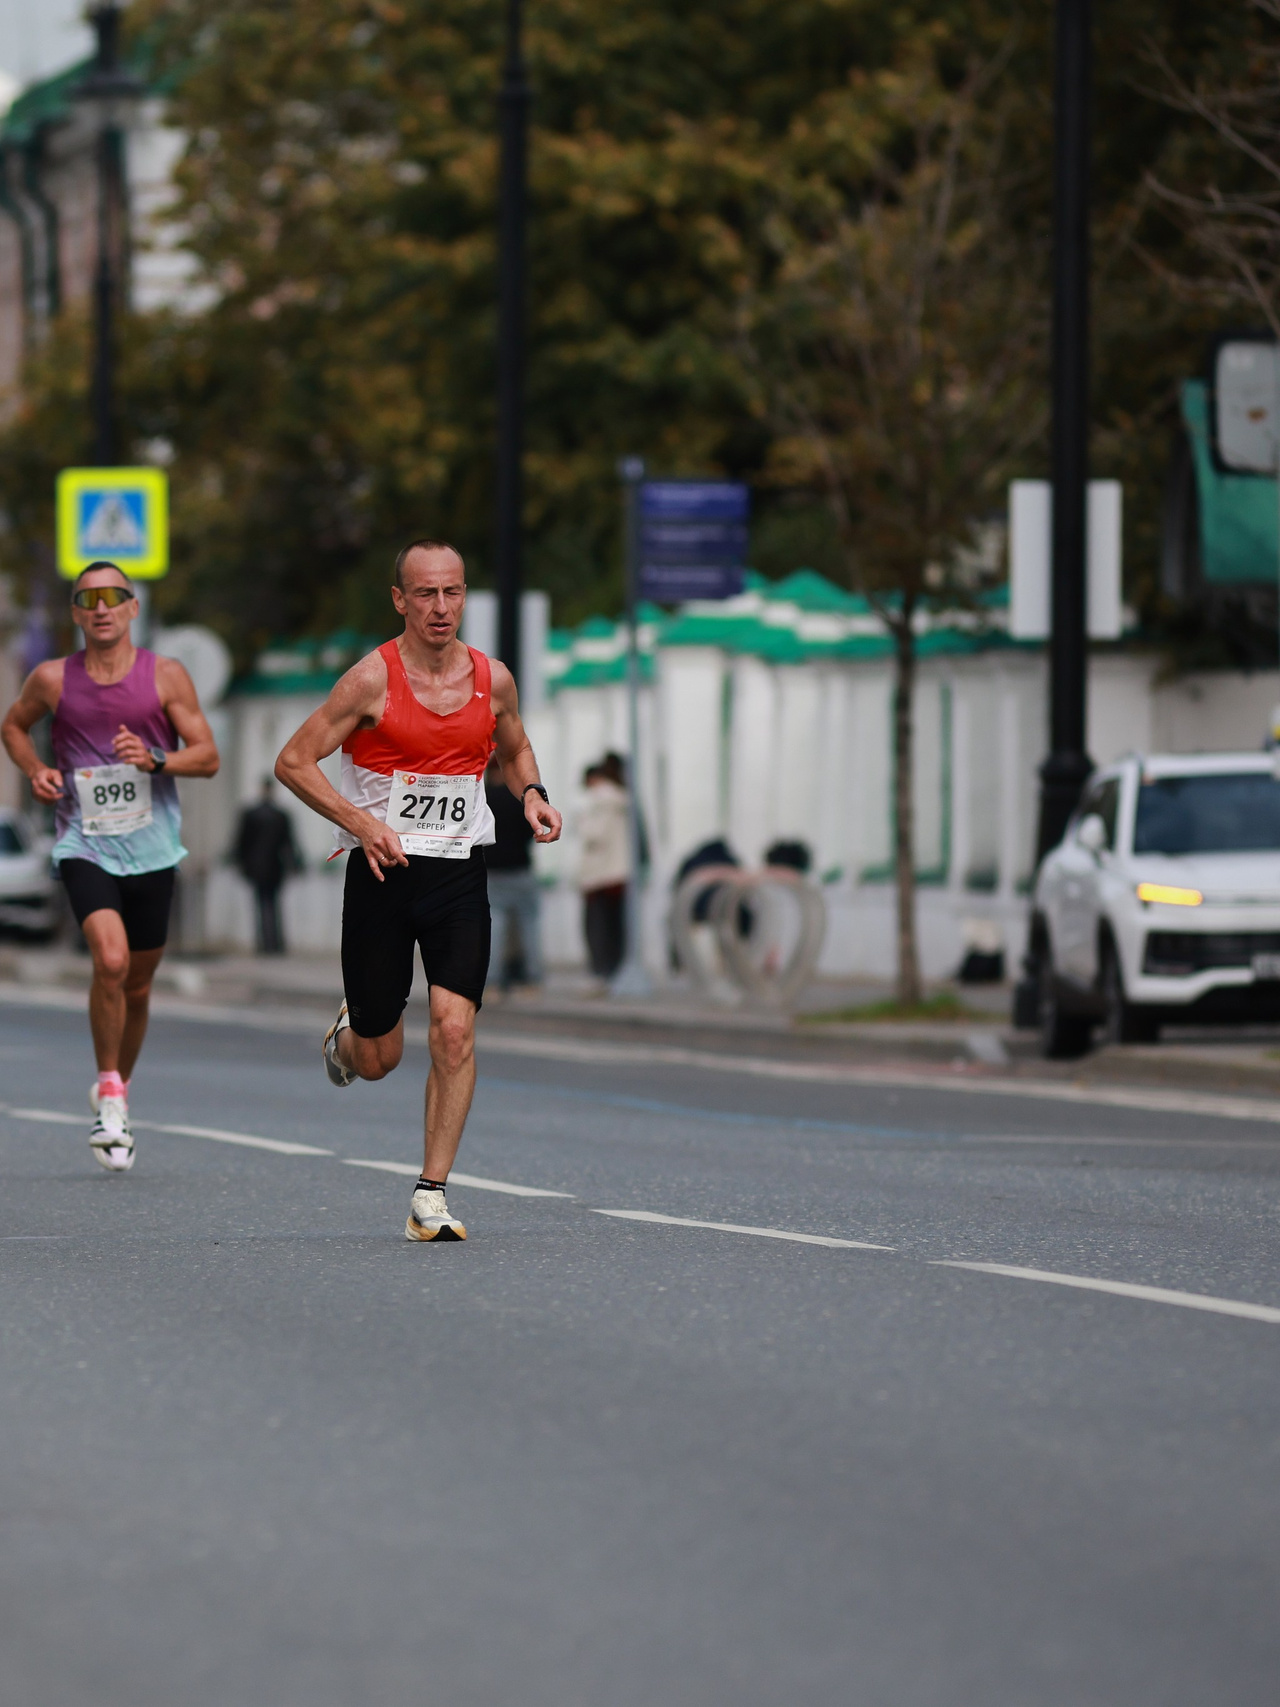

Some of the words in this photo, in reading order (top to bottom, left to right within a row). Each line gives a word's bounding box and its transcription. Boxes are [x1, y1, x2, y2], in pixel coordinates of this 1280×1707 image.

[93, 781, 136, 805] 898
[400, 794, 466, 822] 2718
[416, 822, 446, 831] СЕРГЕЙ
